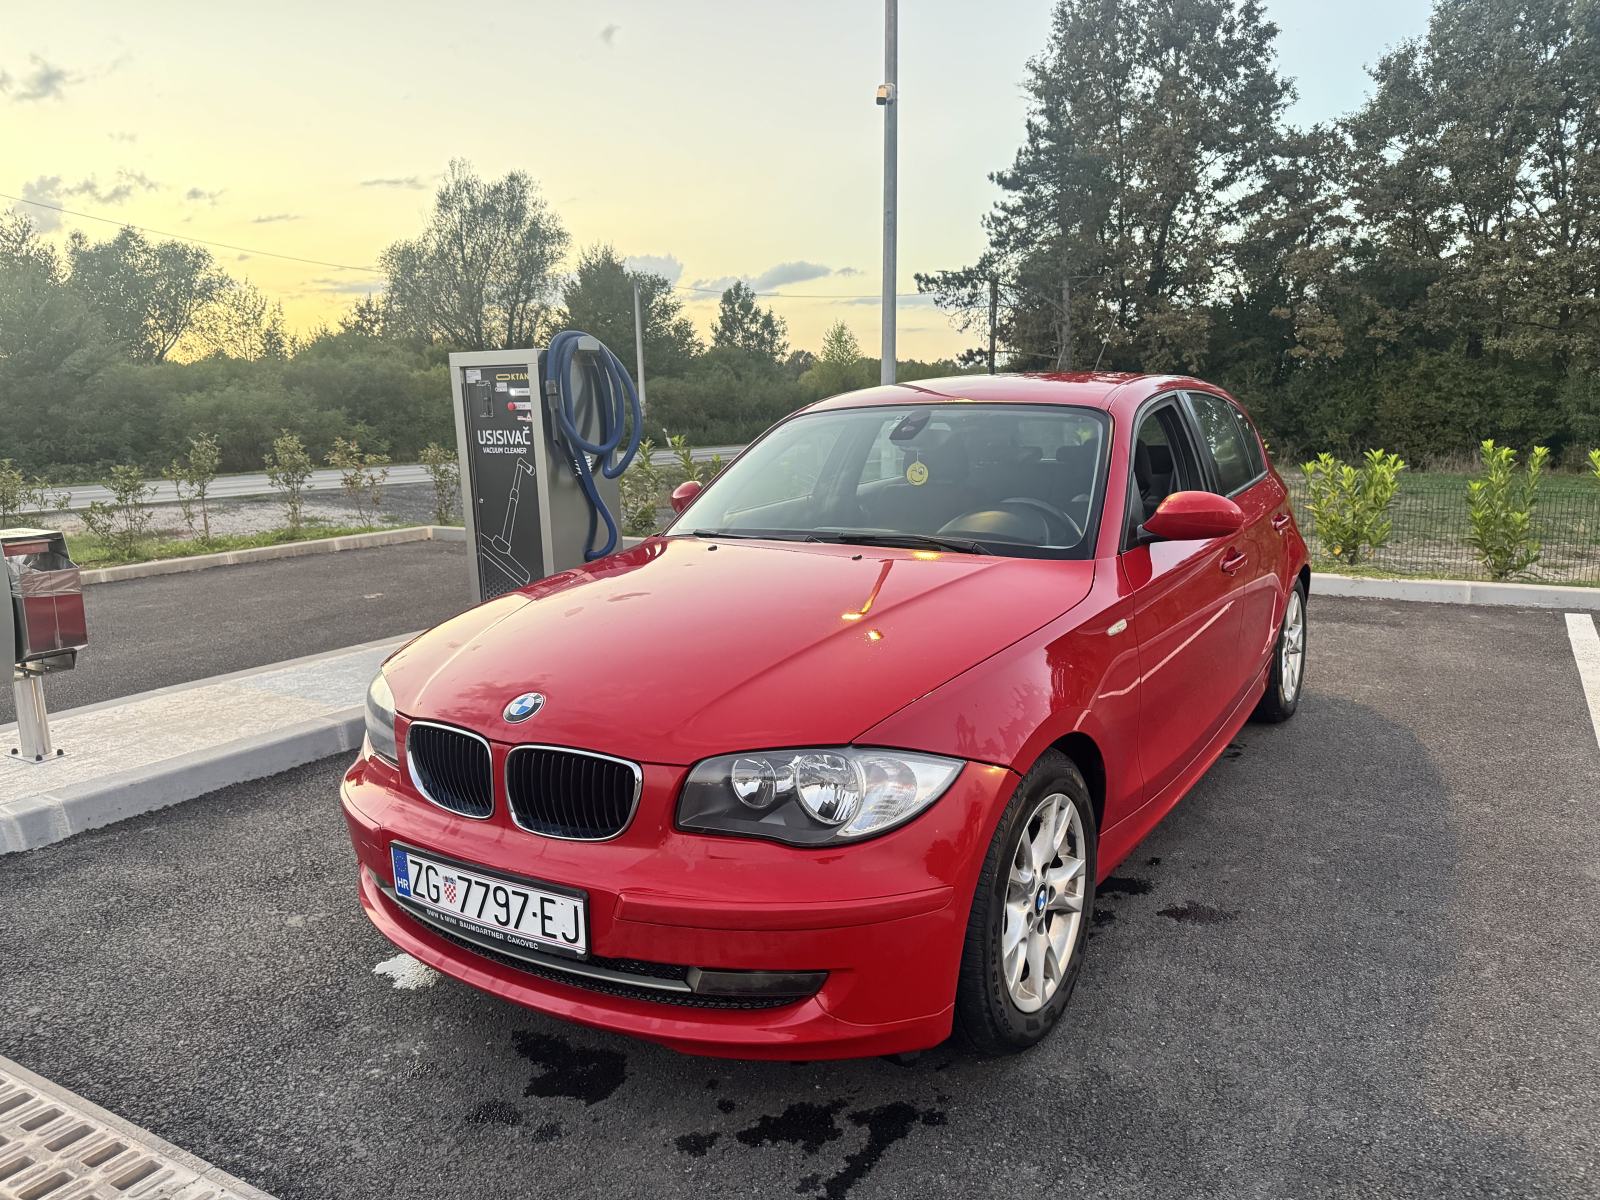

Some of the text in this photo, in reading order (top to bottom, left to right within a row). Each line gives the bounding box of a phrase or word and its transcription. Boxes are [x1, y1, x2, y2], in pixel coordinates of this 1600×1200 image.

[477, 426, 531, 445] USISIVAČ
[397, 876, 410, 891] HR
[410, 859, 440, 904] ZG
[459, 921, 504, 940] BAUMGARTNER
[507, 934, 539, 950] ČAKOVEC
